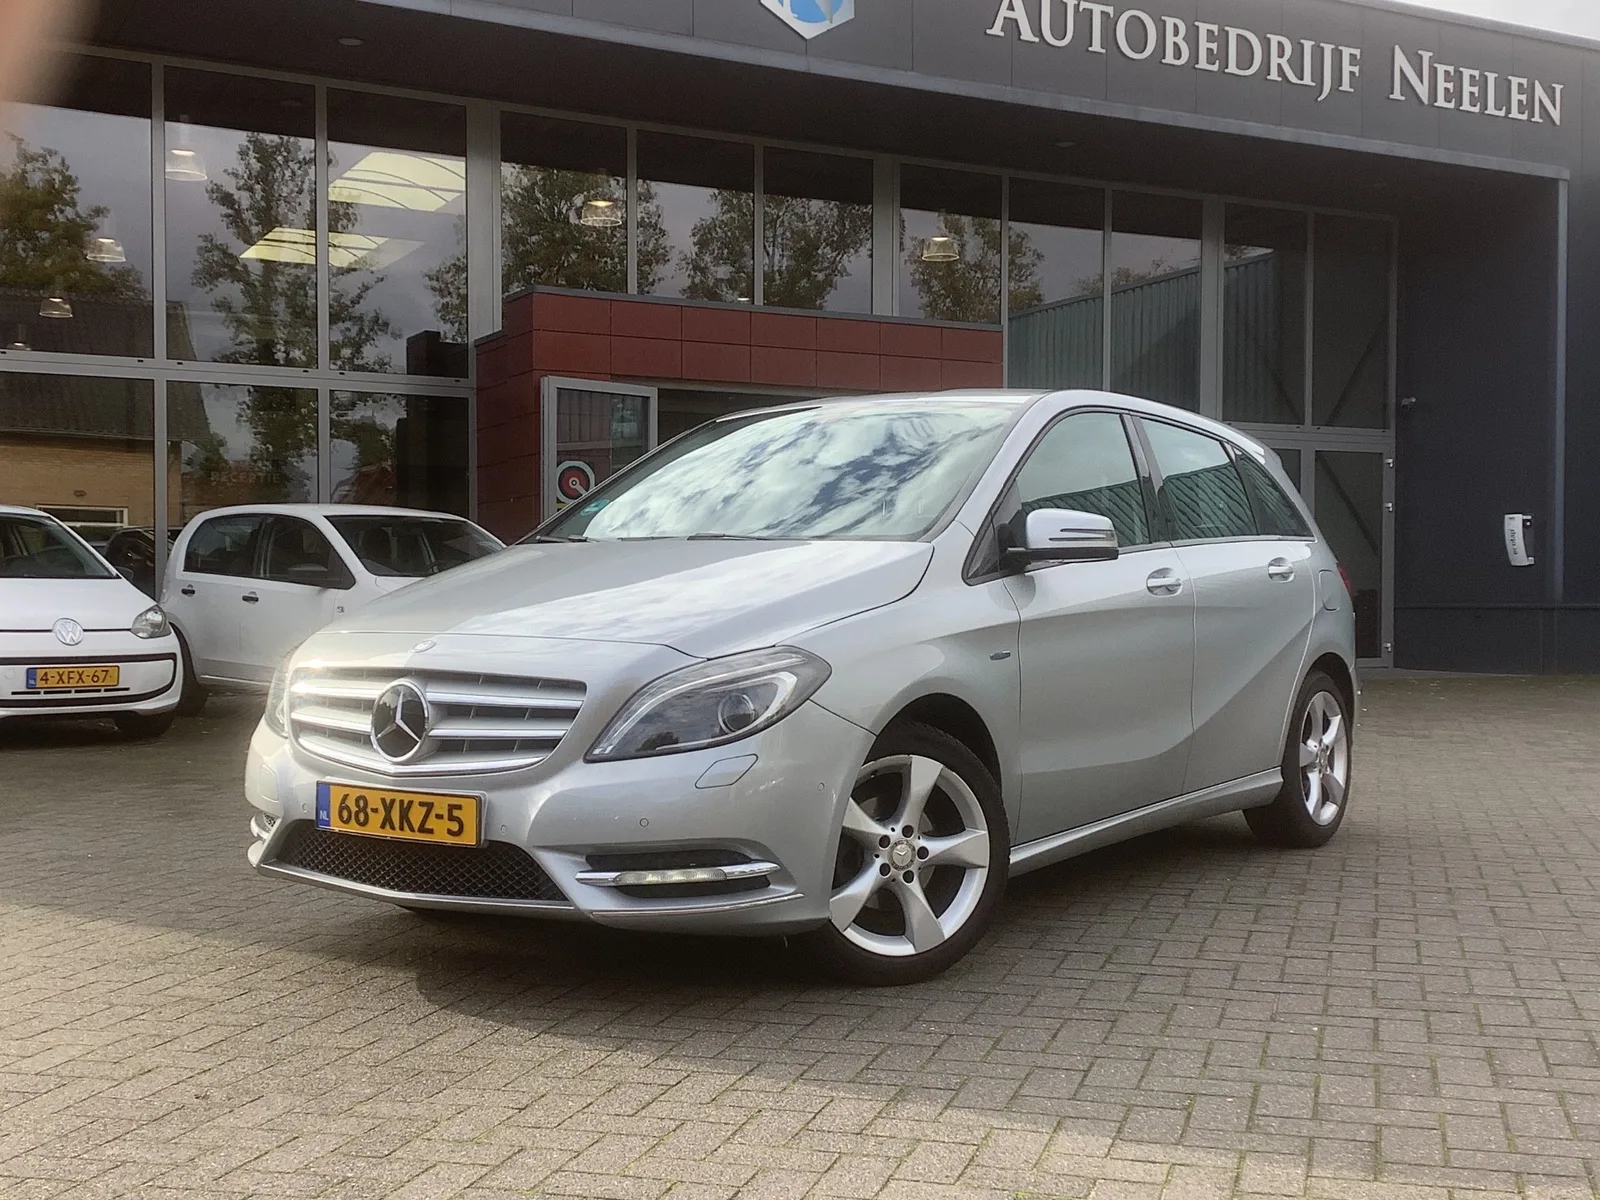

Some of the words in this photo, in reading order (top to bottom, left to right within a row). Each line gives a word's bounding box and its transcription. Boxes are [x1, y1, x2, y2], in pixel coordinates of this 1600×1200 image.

[985, 0, 1361, 102] AUTOBEDRIJF
[1388, 44, 1564, 126] NEELEN
[39, 669, 110, 685] 4-XFX-67
[319, 809, 330, 822] NL
[337, 793, 465, 838] 68-XKZ-5
